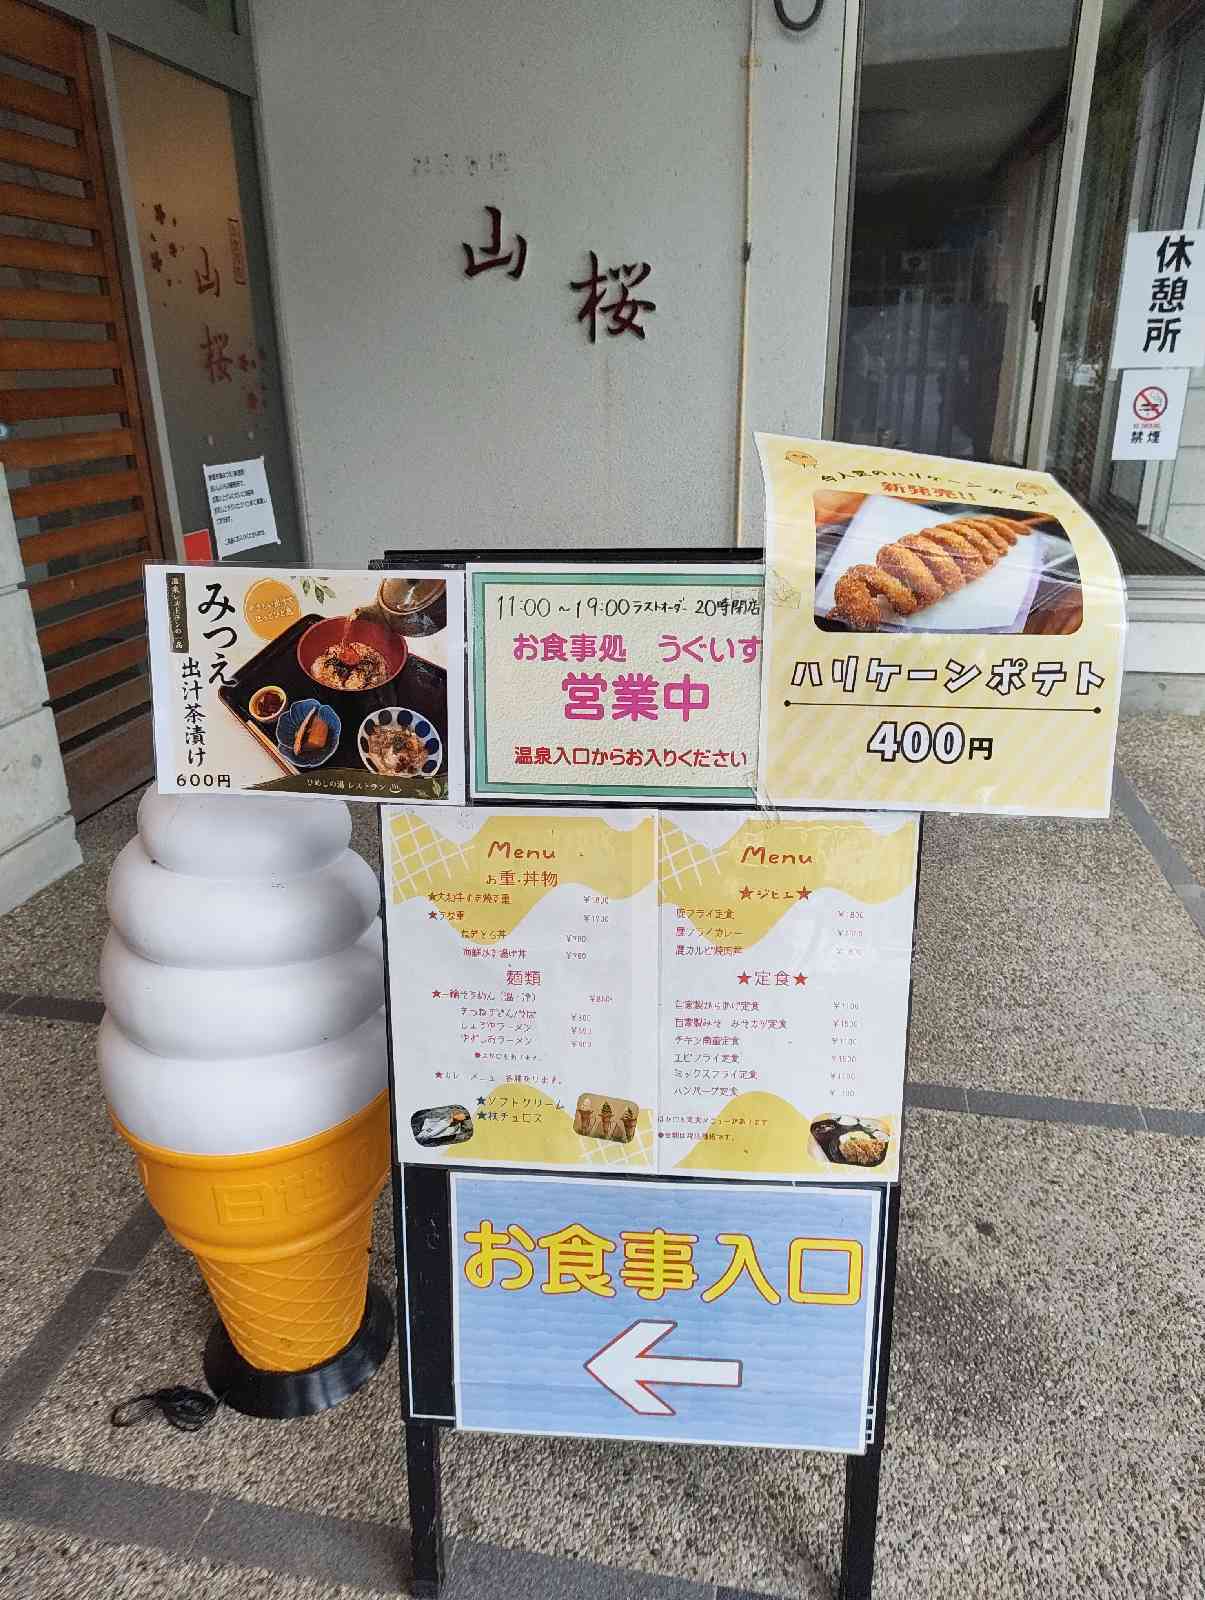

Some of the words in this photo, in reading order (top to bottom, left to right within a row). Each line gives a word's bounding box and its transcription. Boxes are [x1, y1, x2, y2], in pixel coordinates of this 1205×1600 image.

[1142, 234, 1195, 353] 休憩所
[1130, 430, 1161, 444] 禁煙
[198, 582, 239, 687] みつえ
[512, 633, 627, 662] お食事処
[657, 634, 763, 663] うぐいす
[790, 656, 1106, 696] ハリケーンポテト
[181, 657, 207, 768] 出汁茶漬け
[561, 672, 710, 722] 営業中
[513, 746, 748, 768] 温泉入口からお入りください
[866, 721, 994, 763] 400円
[175, 772, 232, 788] 600円
[487, 840, 557, 860] Menu
[740, 845, 815, 865] Menu
[754, 970, 791, 987] 定食
[463, 1219, 864, 1306] お食事入口
